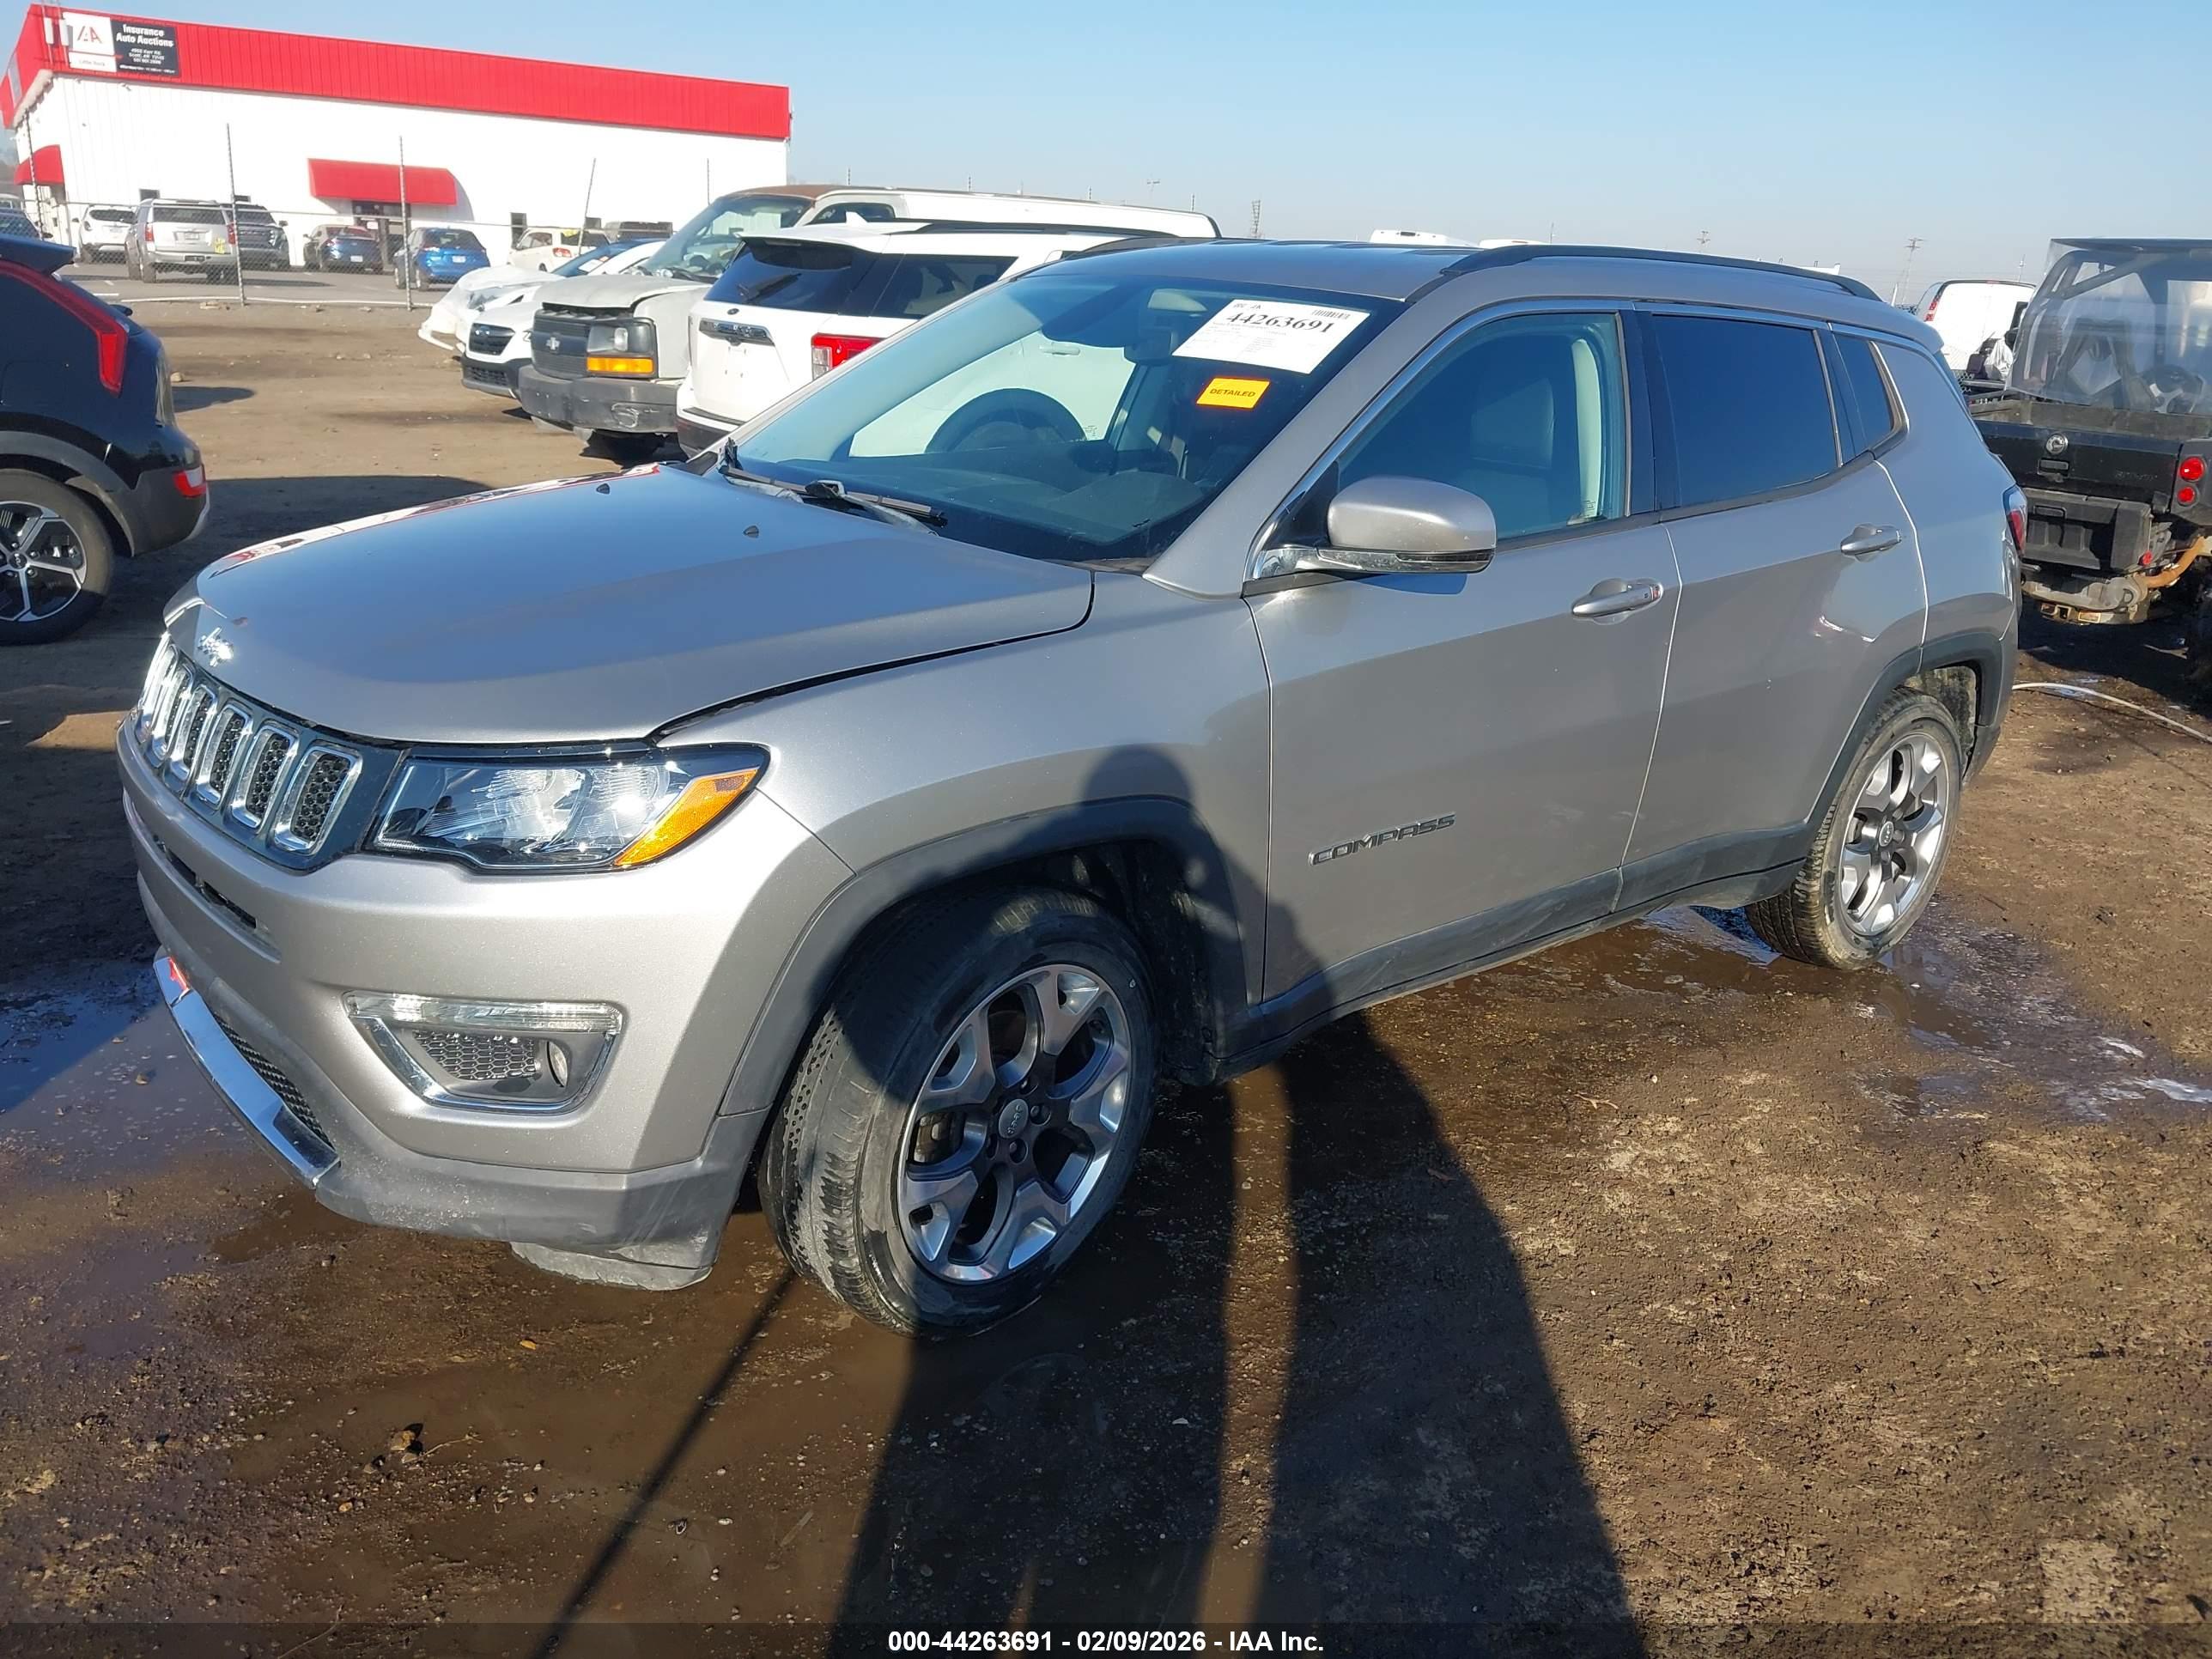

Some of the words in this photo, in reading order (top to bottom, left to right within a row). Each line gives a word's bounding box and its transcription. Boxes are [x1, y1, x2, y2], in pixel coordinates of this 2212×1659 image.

[123, 24, 164, 37] Insurance
[116, 33, 136, 43] Auto
[137, 35, 174, 47] Auctions
[1226, 313, 1334, 332] 44263691
[1209, 388, 1256, 398] DETAILED
[1308, 811, 1456, 866] COMPASS
